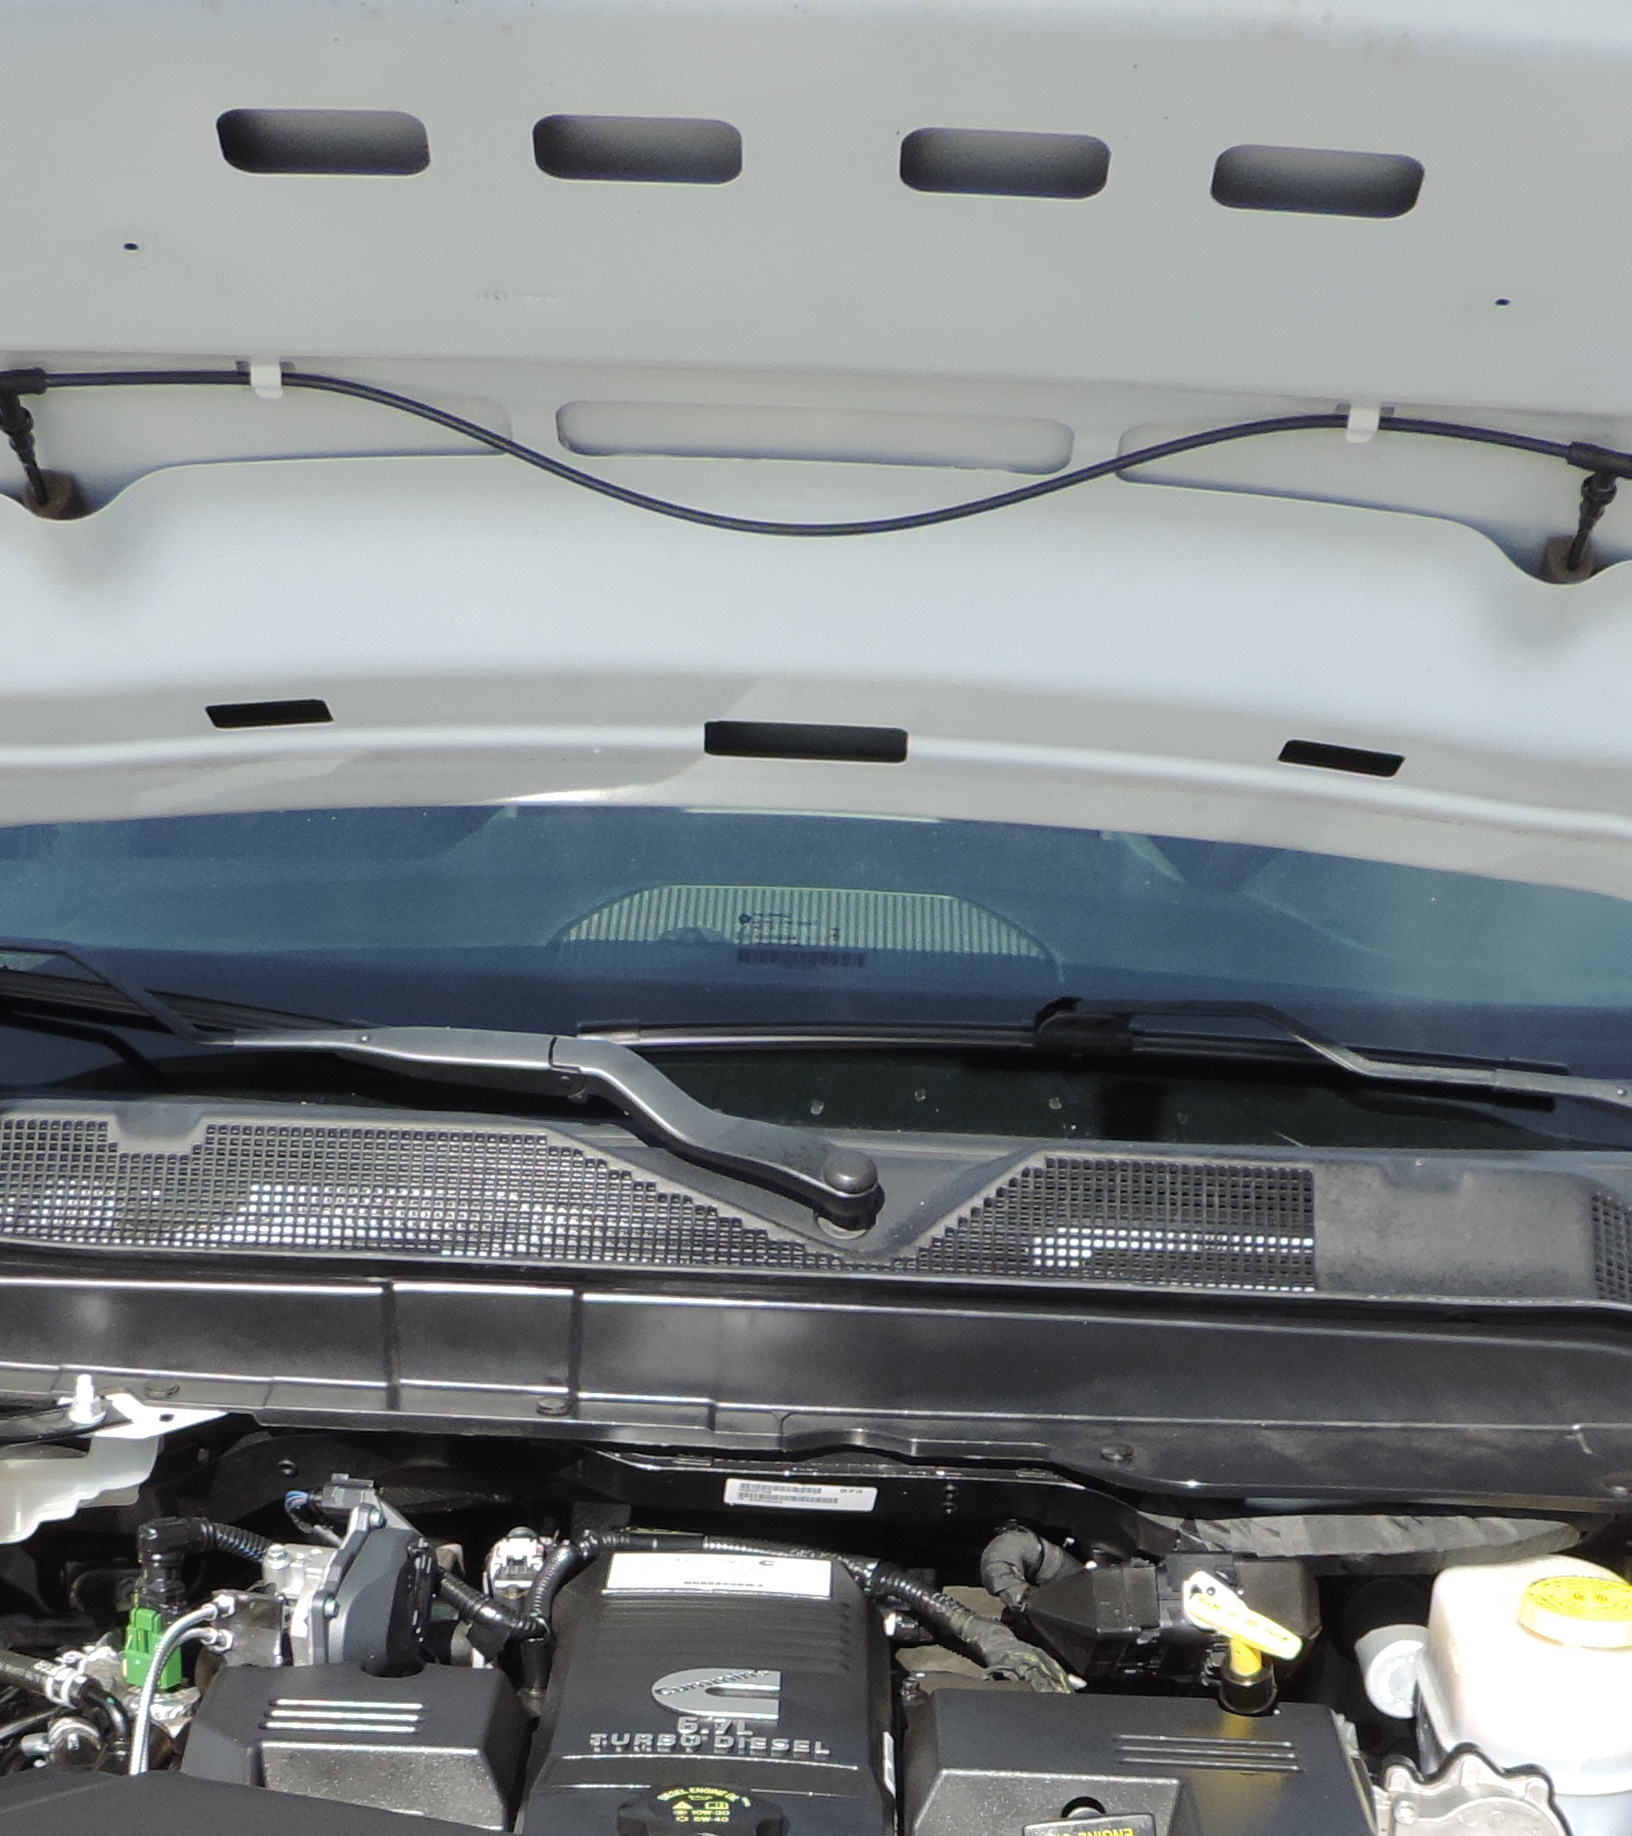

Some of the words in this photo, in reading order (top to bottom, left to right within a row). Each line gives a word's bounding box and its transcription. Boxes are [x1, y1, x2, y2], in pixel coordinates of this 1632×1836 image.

[676, 1715, 754, 1737] 6.7L
[589, 1732, 702, 1749] TURBO
[713, 1734, 831, 1755] DIESEL
